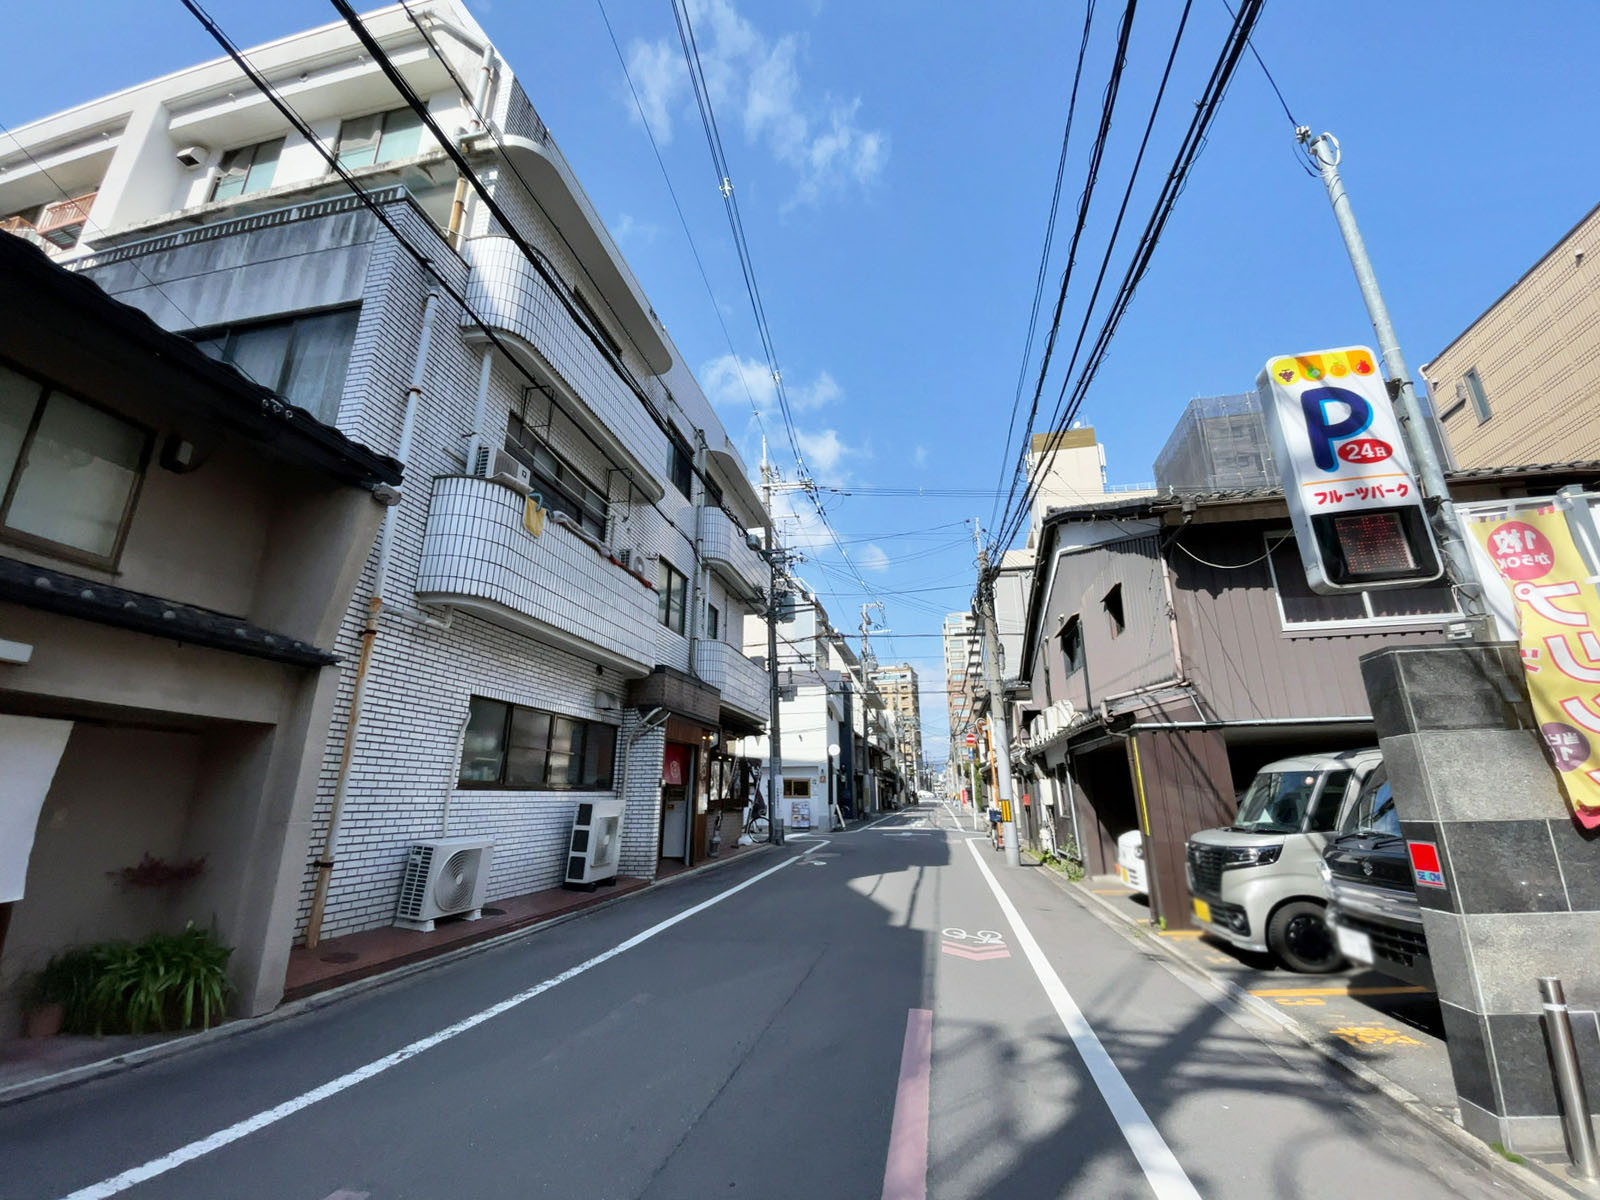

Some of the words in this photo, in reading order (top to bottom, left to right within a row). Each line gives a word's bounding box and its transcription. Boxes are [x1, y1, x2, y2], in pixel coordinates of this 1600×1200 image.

[1301, 387, 1373, 472] P
[1346, 442, 1387, 459] 24H
[1314, 483, 1408, 504] フルーツパーク
